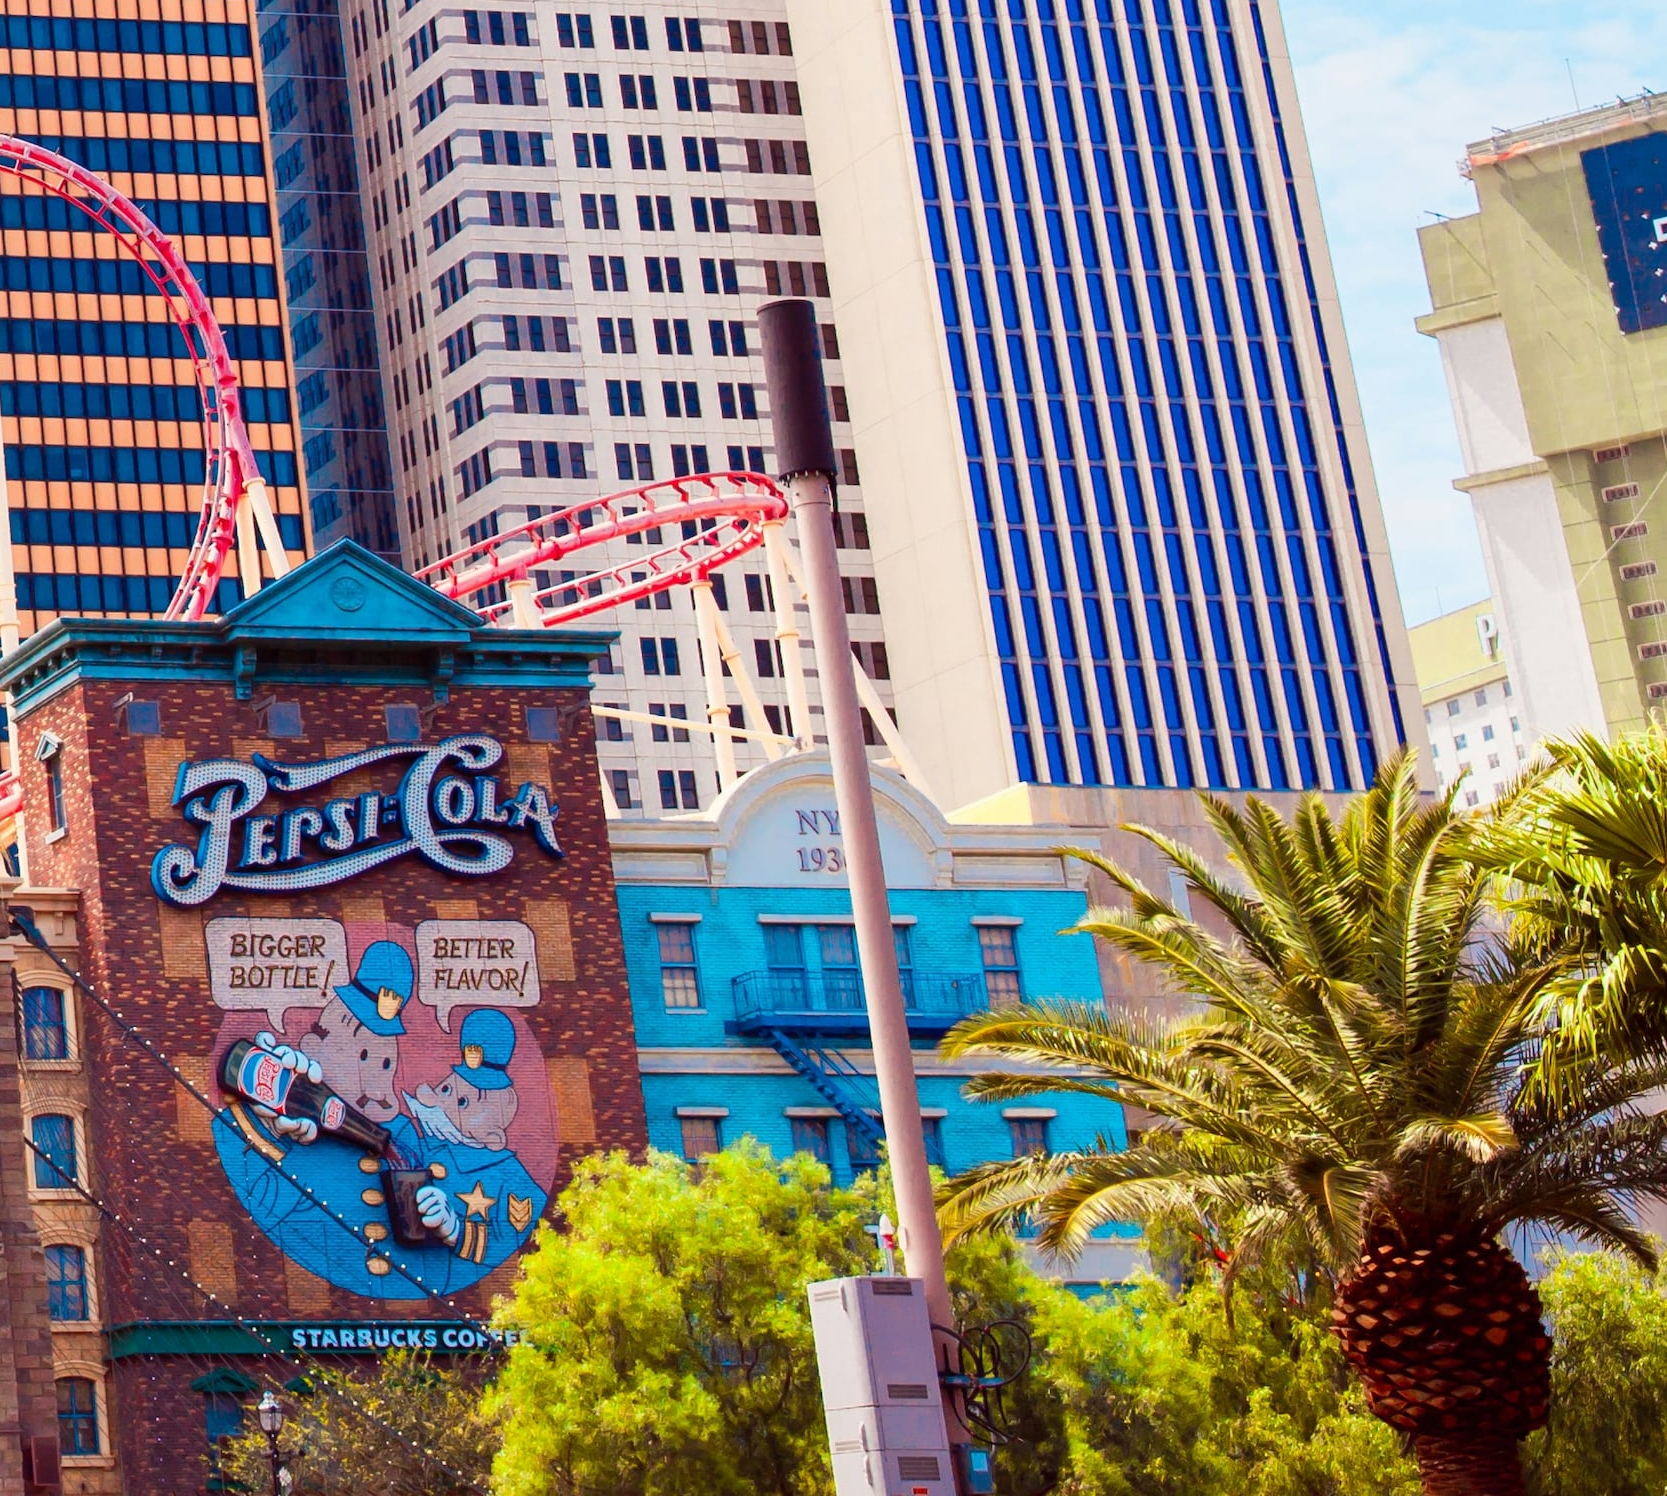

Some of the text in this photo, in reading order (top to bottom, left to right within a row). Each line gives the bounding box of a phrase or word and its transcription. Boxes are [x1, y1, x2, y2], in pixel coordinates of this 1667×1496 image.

[796, 847, 847, 872] 193
[230, 933, 326, 958] BIGGER
[433, 937, 515, 960] BETTER
[230, 959, 336, 997] BOTTLE!
[435, 961, 529, 997] FLAVOR!
[292, 1328, 437, 1349] STARBUCKS
